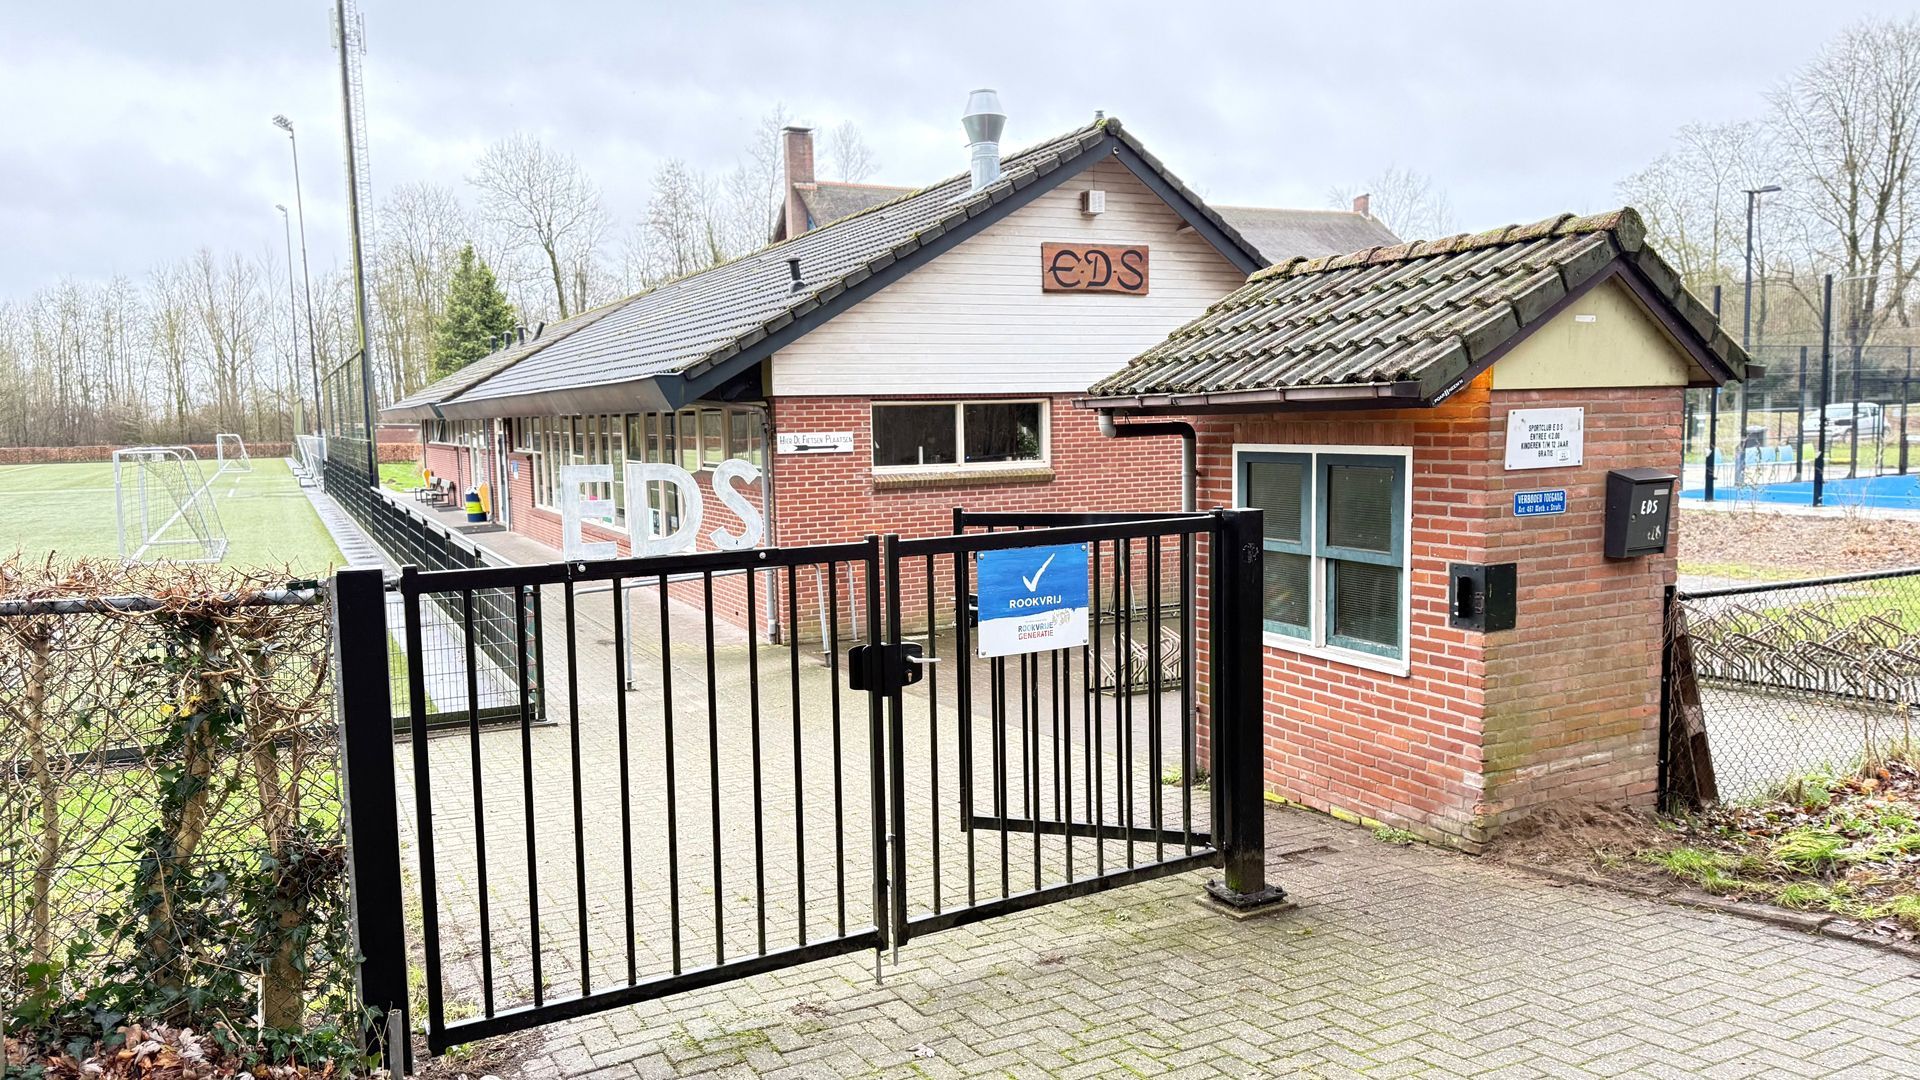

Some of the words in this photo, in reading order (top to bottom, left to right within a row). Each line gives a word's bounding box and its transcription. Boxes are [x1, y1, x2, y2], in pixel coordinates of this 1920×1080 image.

[1528, 424, 1552, 432] SPORTCLUB
[1521, 442, 1541, 450] KINDEREN
[1518, 494, 1542, 504] VERBODEN
[560, 459, 764, 561] EDS
[1641, 500, 1658, 514] EDS
[1009, 595, 1062, 608] ROOKVRIJ
[1018, 622, 1054, 632] ROOKVRIJE
[1018, 630, 1054, 640] GENERATIE
